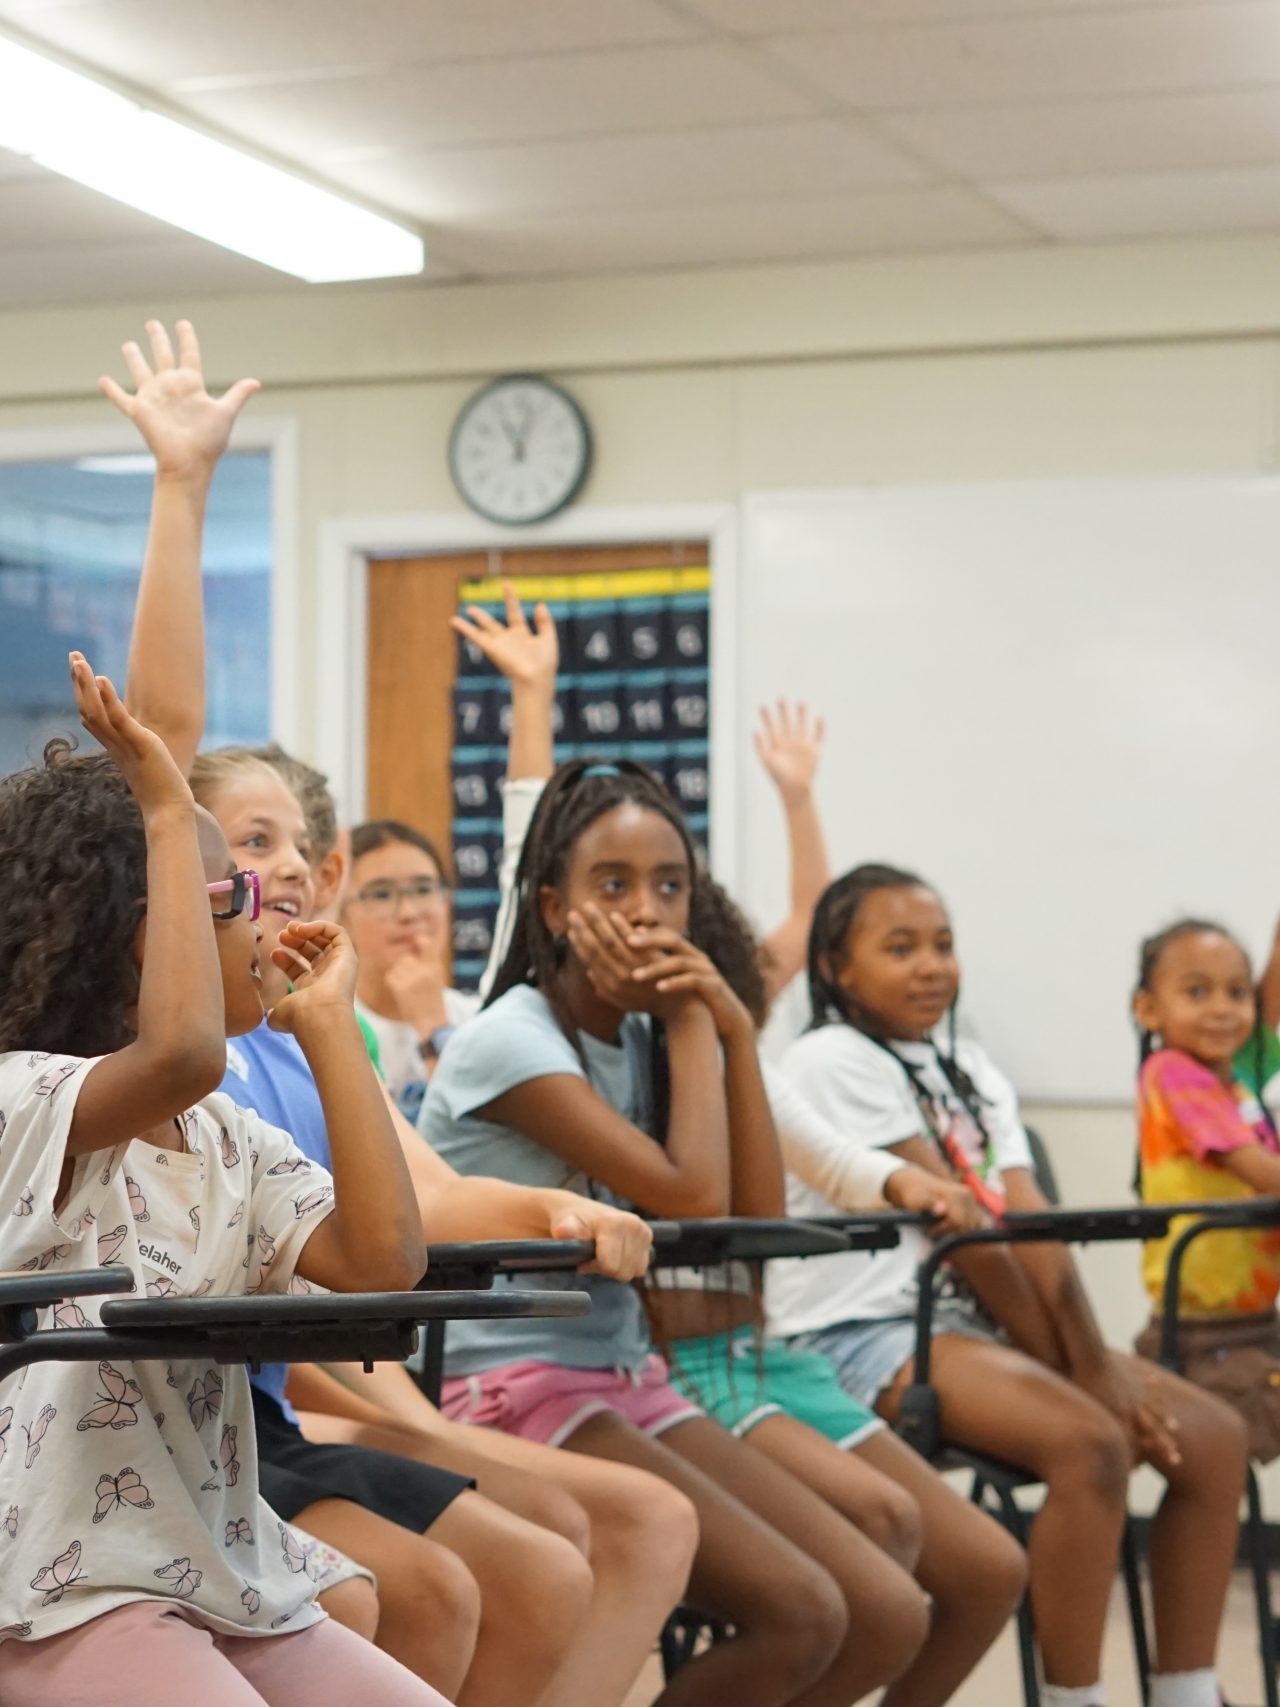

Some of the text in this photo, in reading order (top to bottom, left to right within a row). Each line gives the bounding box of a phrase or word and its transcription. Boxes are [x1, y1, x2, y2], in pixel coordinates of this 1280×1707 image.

[585, 630, 610, 662] 4
[631, 626, 658, 660] 5
[458, 701, 481, 734] 7
[582, 701, 620, 733] 10
[629, 699, 663, 731] 11
[673, 694, 707, 728] 12
[137, 1239, 182, 1275] elaher
